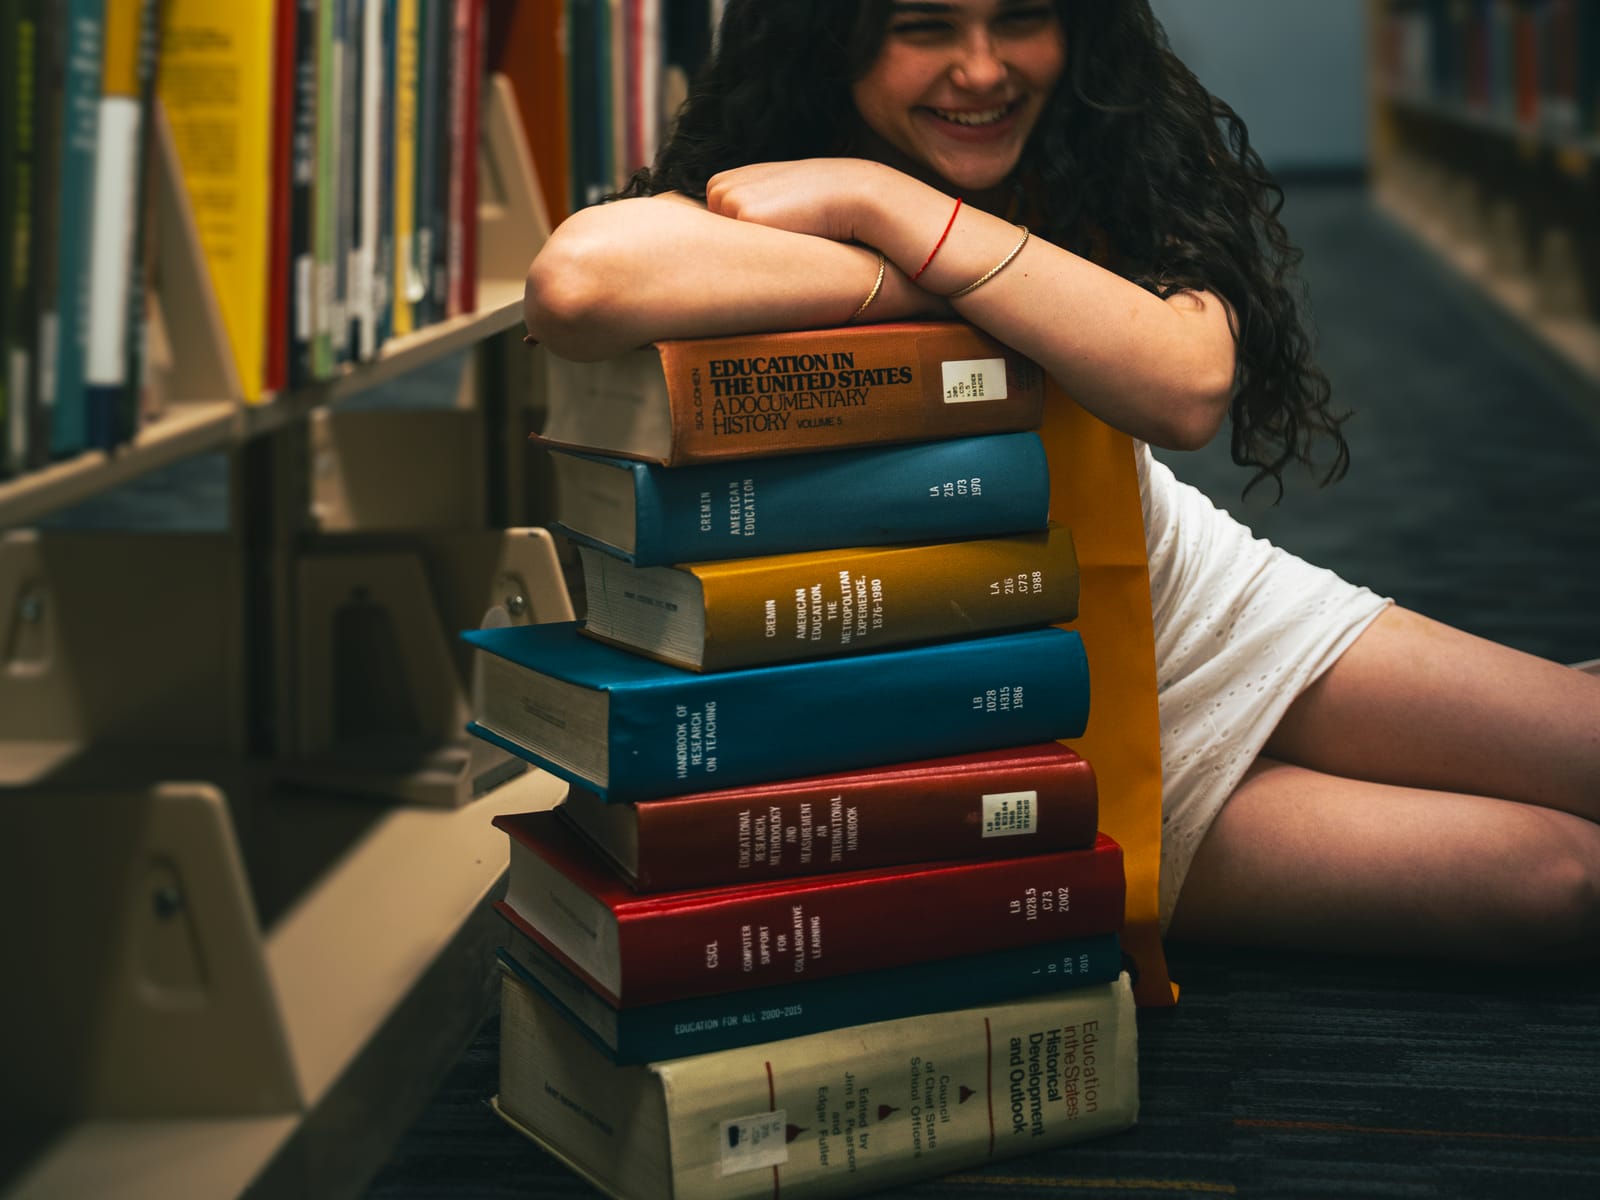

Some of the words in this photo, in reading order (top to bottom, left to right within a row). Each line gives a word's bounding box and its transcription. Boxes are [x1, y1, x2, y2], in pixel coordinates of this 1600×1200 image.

[709, 354, 828, 377] EDUCATION
[833, 352, 854, 369] IN
[691, 367, 703, 407] COHEN
[710, 377, 754, 397] THE
[757, 372, 836, 394] UNITED
[838, 366, 913, 388] STATES
[946, 390, 952, 399] LA
[713, 398, 726, 416] A
[728, 388, 870, 416] DOCUMENTARY
[695, 411, 704, 431] SOL
[713, 412, 791, 436] HISTORY
[797, 417, 835, 429] VOLUME
[837, 416, 843, 426] 5
[929, 486, 940, 497] LA
[943, 482, 954, 498] 215
[971, 477, 982, 497] 1970
[700, 492, 712, 532] CREMIN
[729, 482, 741, 535] AMERICAN
[743, 479, 755, 536] EDUCATION
[990, 581, 1000, 595] LA
[1004, 577, 1014, 595] 216
[1018, 573, 1029, 595] .C73
[1032, 570, 1042, 594] 1988
[765, 599, 776, 638] CREMIN
[795, 588, 807, 639] AMERICAN
[810, 583, 822, 641] EDUCATION,
[827, 600, 838, 620] THE
[839, 570, 853, 644] METROPOLITAN
[871, 578, 883, 629] 1876-1980
[676, 704, 688, 718] OF
[973, 696, 983, 710] LB
[986, 689, 997, 713] 1028
[1000, 686, 1010, 712] .H315
[1013, 686, 1024, 709] 1986
[690, 711, 702, 766] RESEARCH
[705, 701, 717, 752] TEACHING
[676, 723, 688, 779] HANDBOOK
[705, 756, 717, 773] ON
[738, 808, 751, 869] EDUCATIONAL
[755, 815, 767, 862] RESEARCH,
[769, 806, 782, 866] METHODOLOGY
[786, 826, 797, 843] AND
[800, 803, 813, 864] MEASUREMENT
[816, 825, 828, 837] AN
[830, 794, 842, 863] INTERNATIONAL
[846, 806, 858, 852] HANDBOOK
[1010, 900, 1021, 914] LB
[1025, 887, 1037, 920] 1028.5
[1042, 890, 1053, 912] .C73
[1058, 886, 1069, 912] 2002
[741, 924, 752, 972] COMPUTER
[760, 926, 770, 965] SUPPORT
[777, 934, 788, 952] FOR
[792, 904, 804, 973] COLLABORATIVE
[810, 916, 821, 959] LEARNING
[706, 940, 718, 969] CSCL
[1047, 963, 1057, 973] 10
[1079, 953, 1089, 974] 2015
[674, 1019, 719, 1035] EDUCATION
[722, 1015, 738, 1027] FOR
[742, 1012, 756, 1024] ALL
[760, 1004, 803, 1021] 2000-2015
[1064, 1024, 1080, 1038] in
[925, 1062, 936, 1073] of
[1009, 1037, 1025, 1067] and
[1046, 1028, 1062, 1102] Historical
[1064, 1038, 1080, 1065] the
[1082, 1019, 1100, 1113] Education
[845, 1071, 856, 1096] Jim
[911, 1056, 922, 1101] School
[925, 1076, 936, 1109] Chief
[1026, 1032, 1046, 1137] Development
[1064, 1065, 1080, 1121] States:
[816, 1086, 829, 1123] Edgar
[858, 1087, 870, 1129] Edited
[939, 1075, 950, 1123] Council
[1010, 1068, 1028, 1135] Outlook
[832, 1111, 842, 1136] and
[911, 1105, 922, 1159] Officers
[925, 1112, 937, 1149] State
[818, 1129, 830, 1166] Fuller
[845, 1118, 857, 1173] Pearson
[859, 1133, 870, 1150] by
